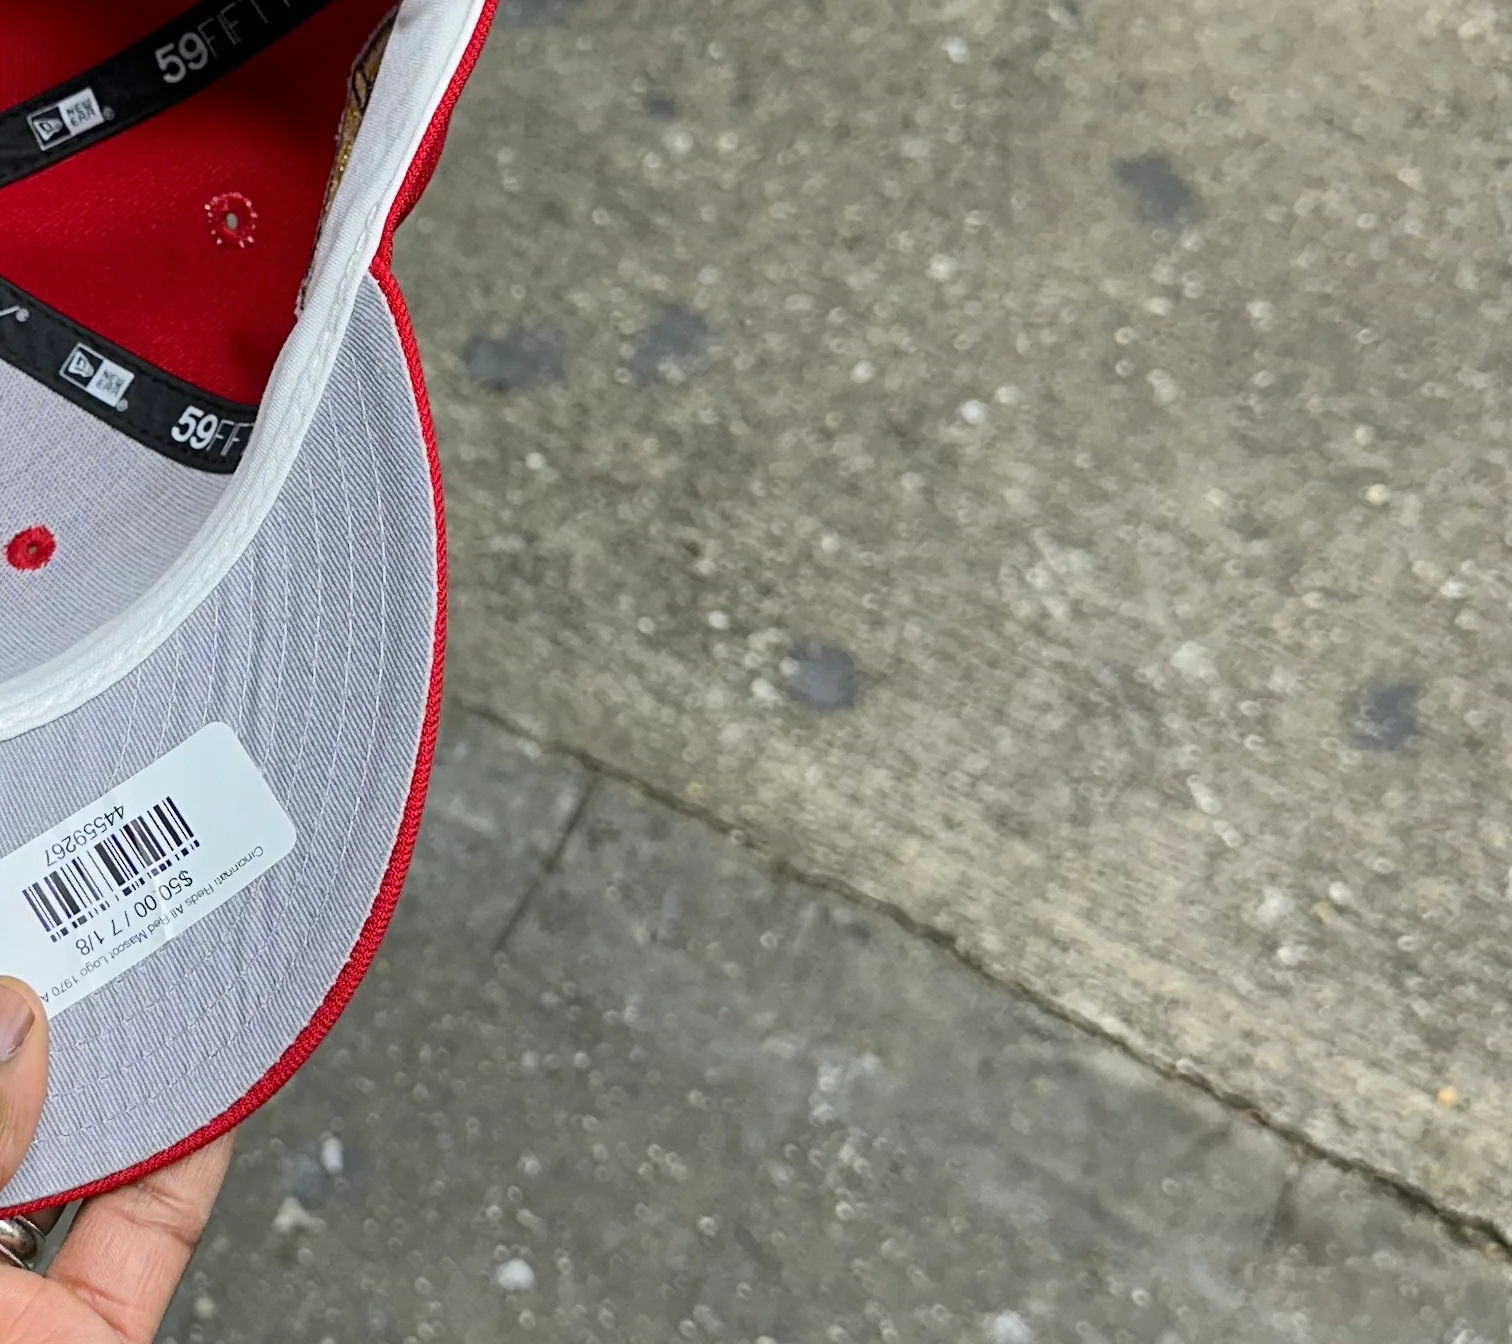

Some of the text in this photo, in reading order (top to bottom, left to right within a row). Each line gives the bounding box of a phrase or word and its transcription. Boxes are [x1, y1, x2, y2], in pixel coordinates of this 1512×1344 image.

[45, 805, 124, 868] 44559267
[184, 884, 215, 907] Reds
[169, 903, 184, 919] All
[111, 919, 124, 936] 7
[147, 914, 170, 934] Red
[75, 930, 105, 956] 1/8
[108, 929, 148, 960] Mascot
[79, 955, 109, 977] Logo
[51, 976, 78, 997] 1970
